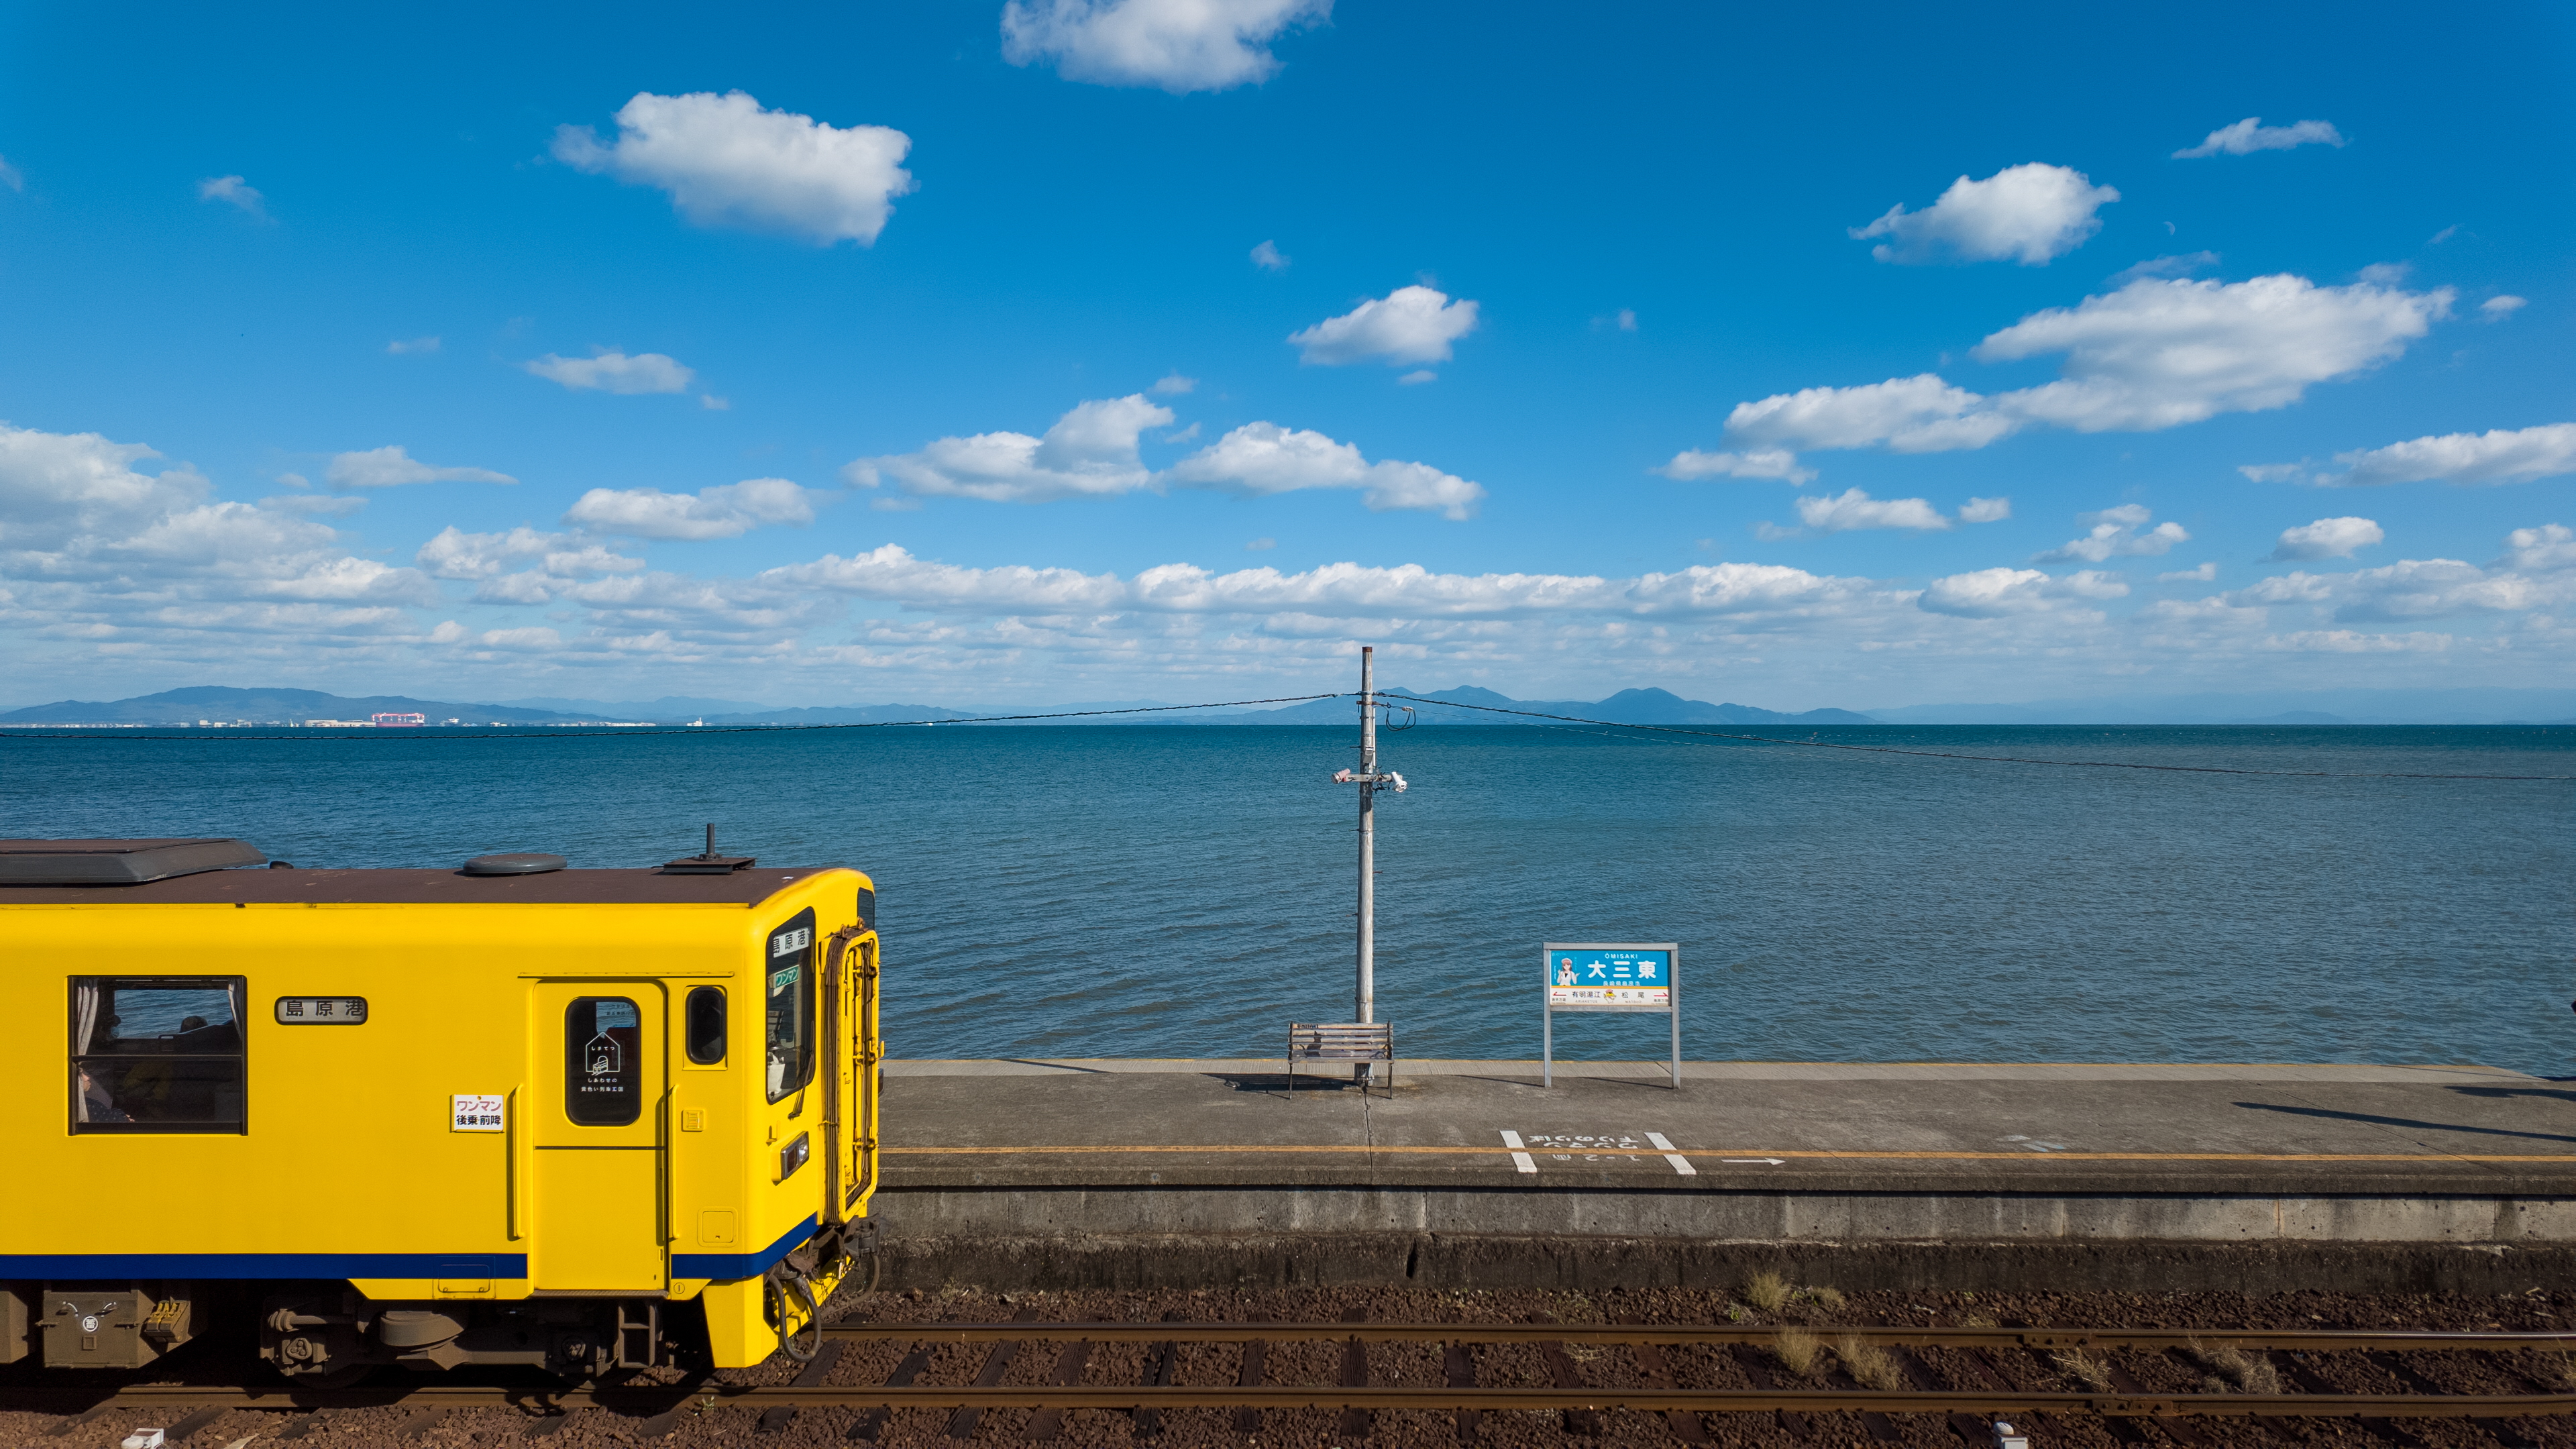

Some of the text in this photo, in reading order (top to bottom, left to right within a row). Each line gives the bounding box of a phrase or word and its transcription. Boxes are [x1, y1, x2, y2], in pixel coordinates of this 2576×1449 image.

[773, 930, 805, 953] 島原港
[776, 969, 798, 986] ワンマン
[1587, 959, 1657, 979] 大三東
[286, 1000, 363, 1017] 島原港
[457, 1100, 501, 1112] ワンマン
